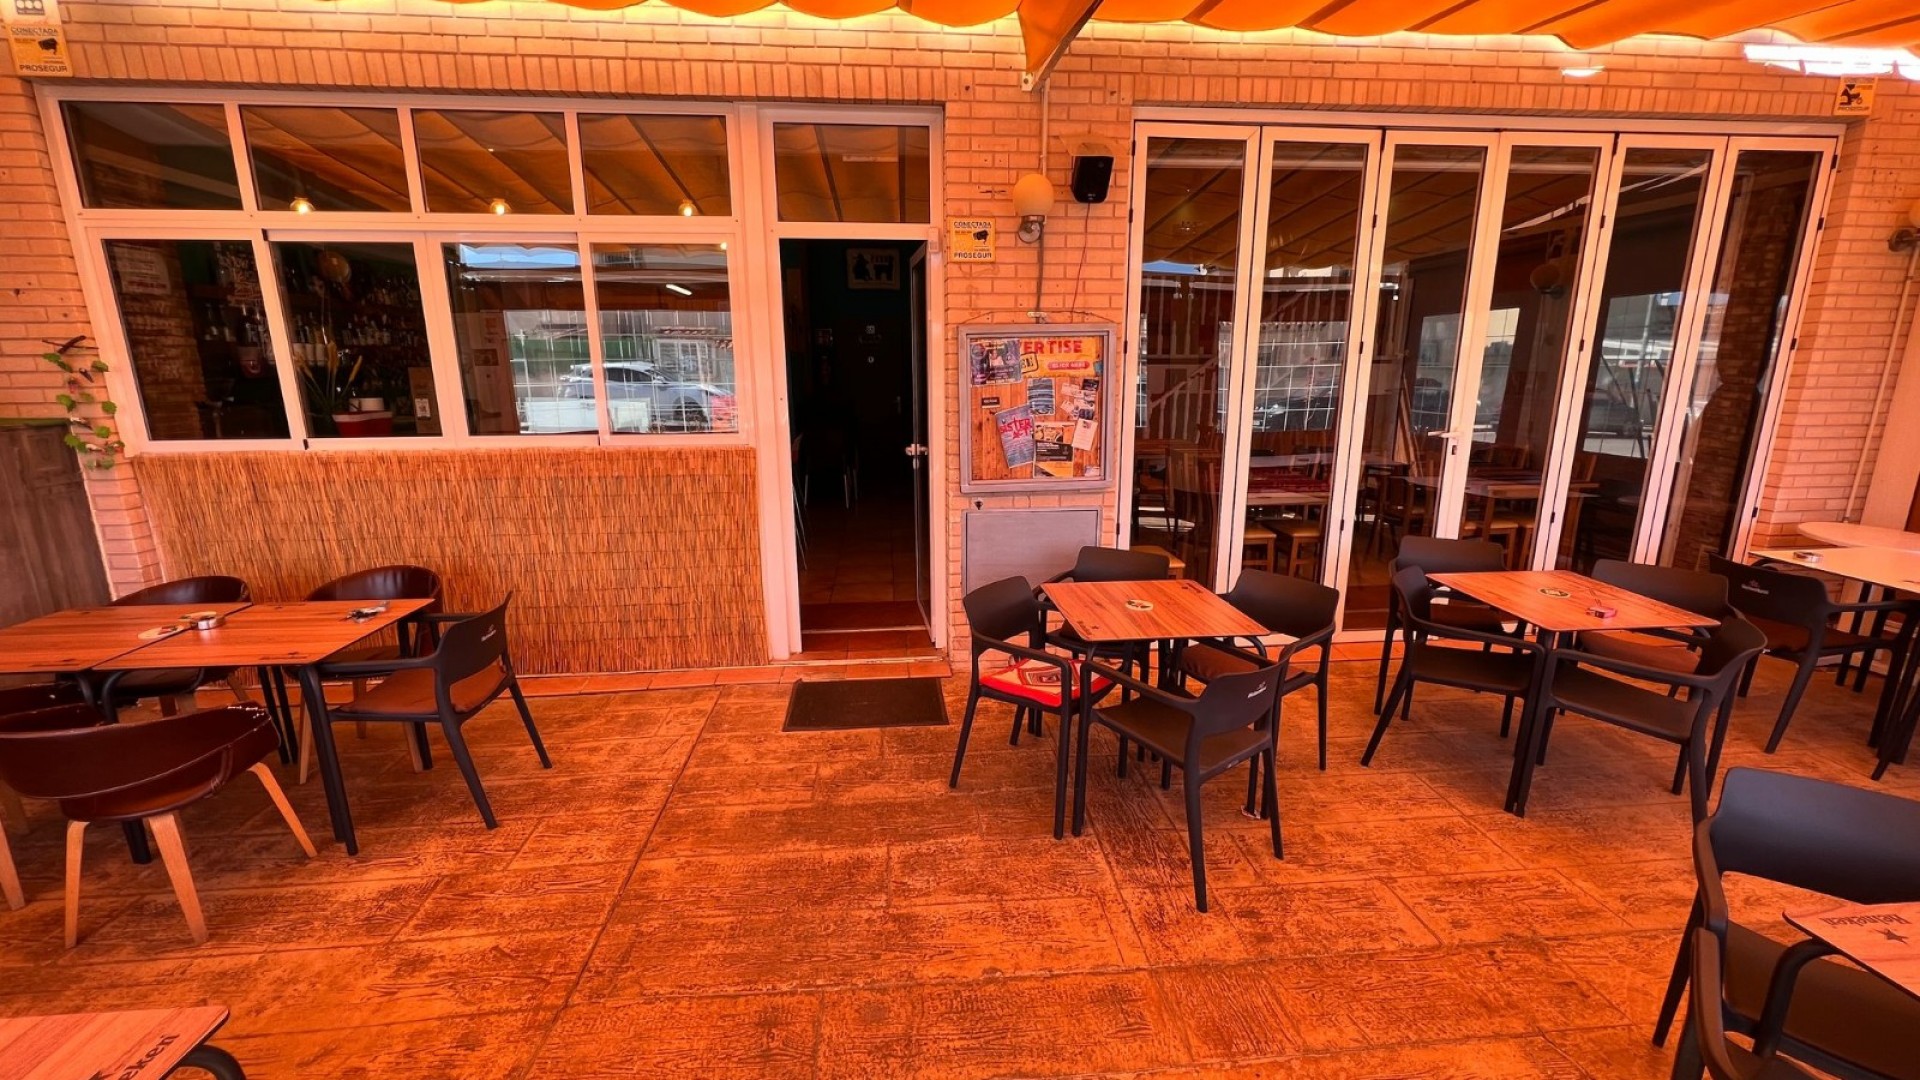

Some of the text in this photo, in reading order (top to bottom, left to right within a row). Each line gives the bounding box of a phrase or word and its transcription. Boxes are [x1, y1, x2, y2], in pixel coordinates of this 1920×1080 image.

[19, 64, 68, 72] PROSEGUR
[1019, 340, 1083, 354] ERTISE
[1000, 416, 1033, 434] SISTER
[1012, 428, 1030, 440] ACT
[117, 1033, 180, 1080] eken
